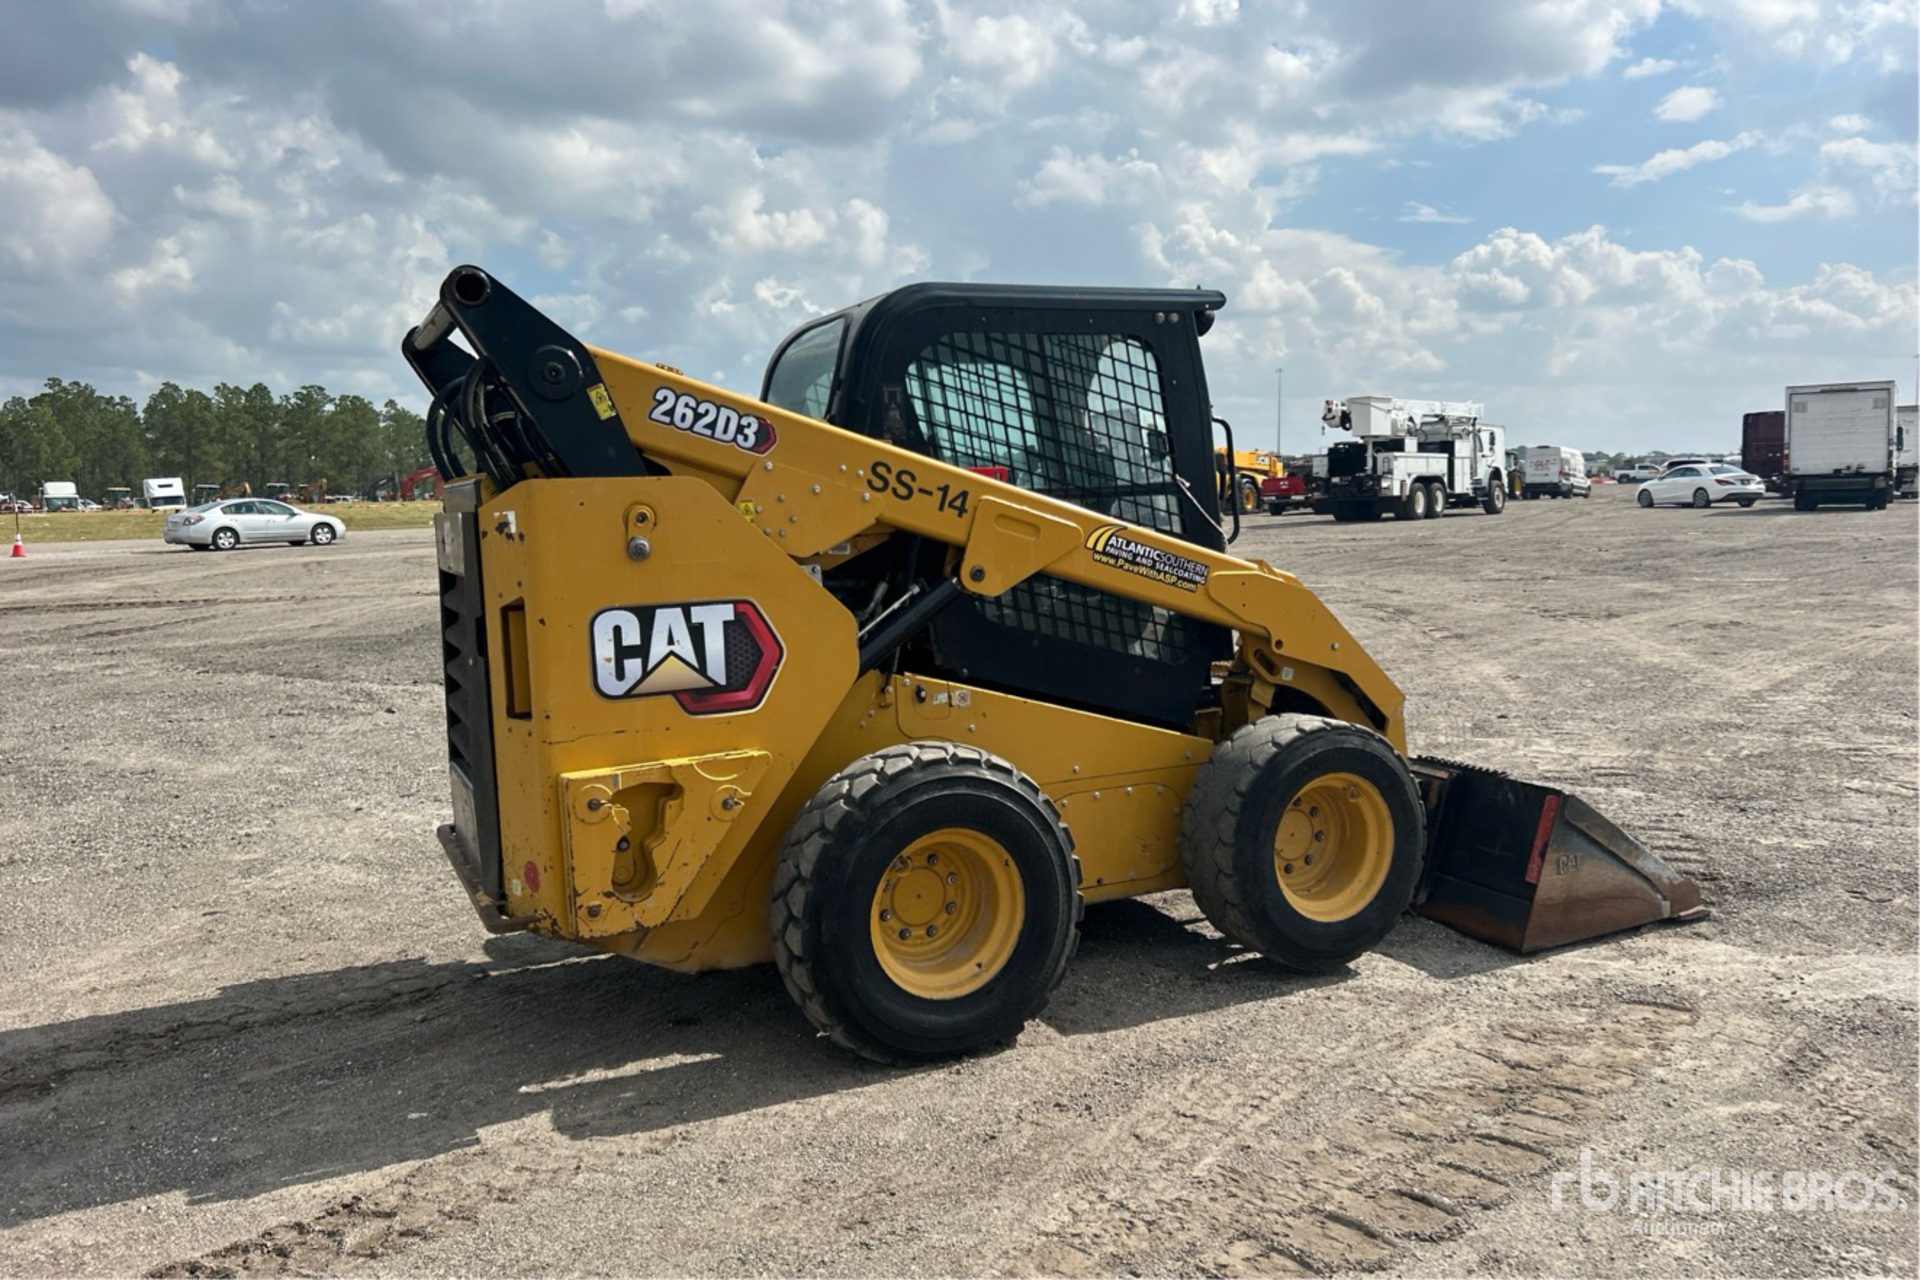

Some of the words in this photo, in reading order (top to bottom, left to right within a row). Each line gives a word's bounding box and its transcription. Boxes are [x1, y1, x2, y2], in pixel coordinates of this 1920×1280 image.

[650, 387, 760, 450] 262D3
[866, 460, 970, 518] SS-14
[1093, 552, 1197, 591] www.PaveWithASP.com
[1105, 546, 1133, 560] PAVING
[1136, 556, 1153, 567] AND
[1155, 561, 1206, 584] SEALCOATING
[593, 603, 735, 696] CAT
